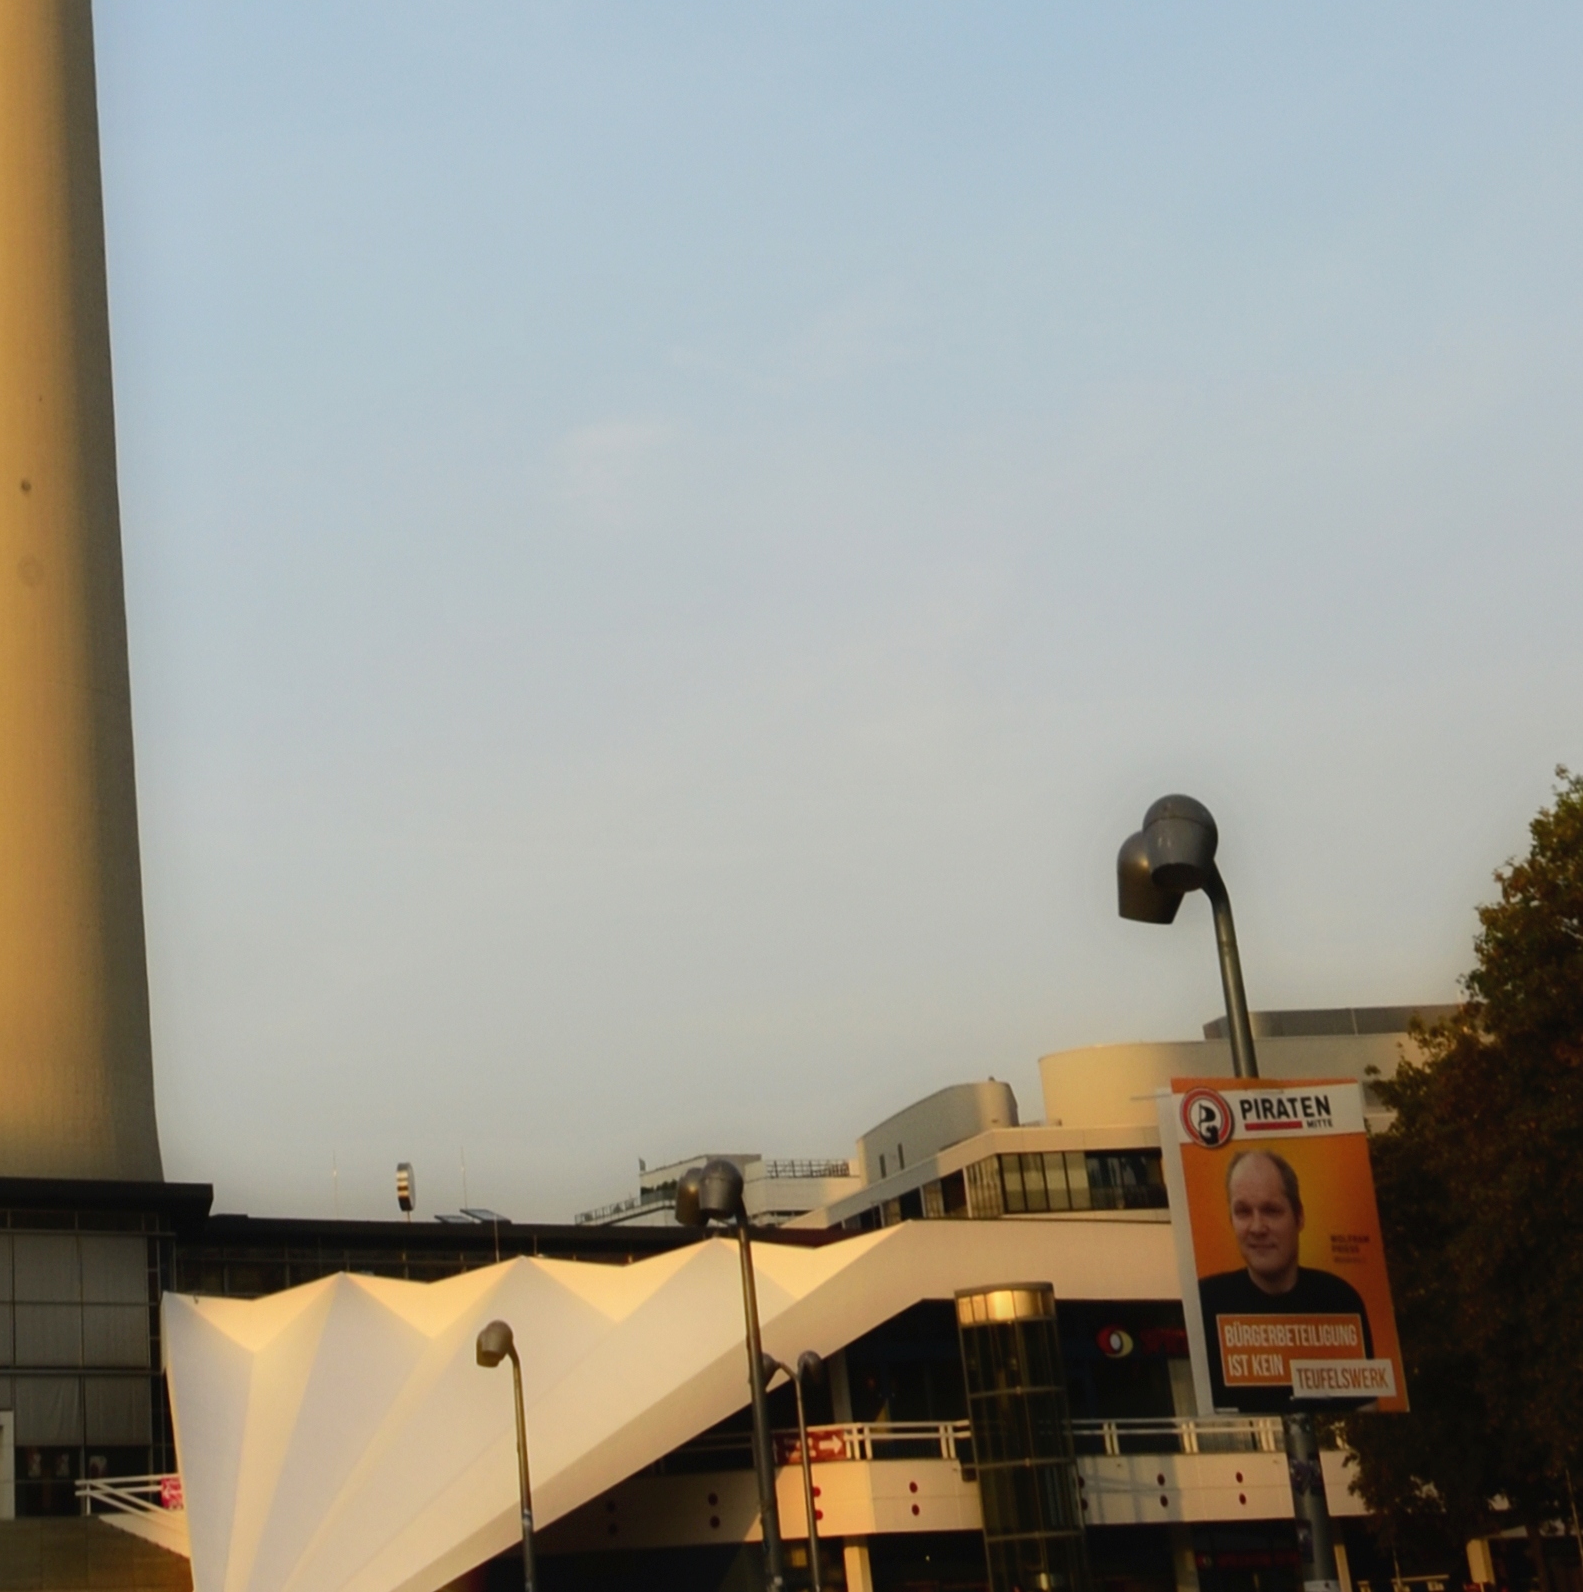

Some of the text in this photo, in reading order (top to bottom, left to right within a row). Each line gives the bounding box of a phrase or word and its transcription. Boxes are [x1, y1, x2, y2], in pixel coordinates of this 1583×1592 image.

[1239, 1094, 1332, 1120] PIRATEN
[1306, 1118, 1334, 1129] MITTE
[1223, 1322, 1358, 1348] BÜRGERBETEILIGUNG
[1228, 1353, 1283, 1377] IST KEIN
[1296, 1366, 1389, 1390] TEUFELSWERK
